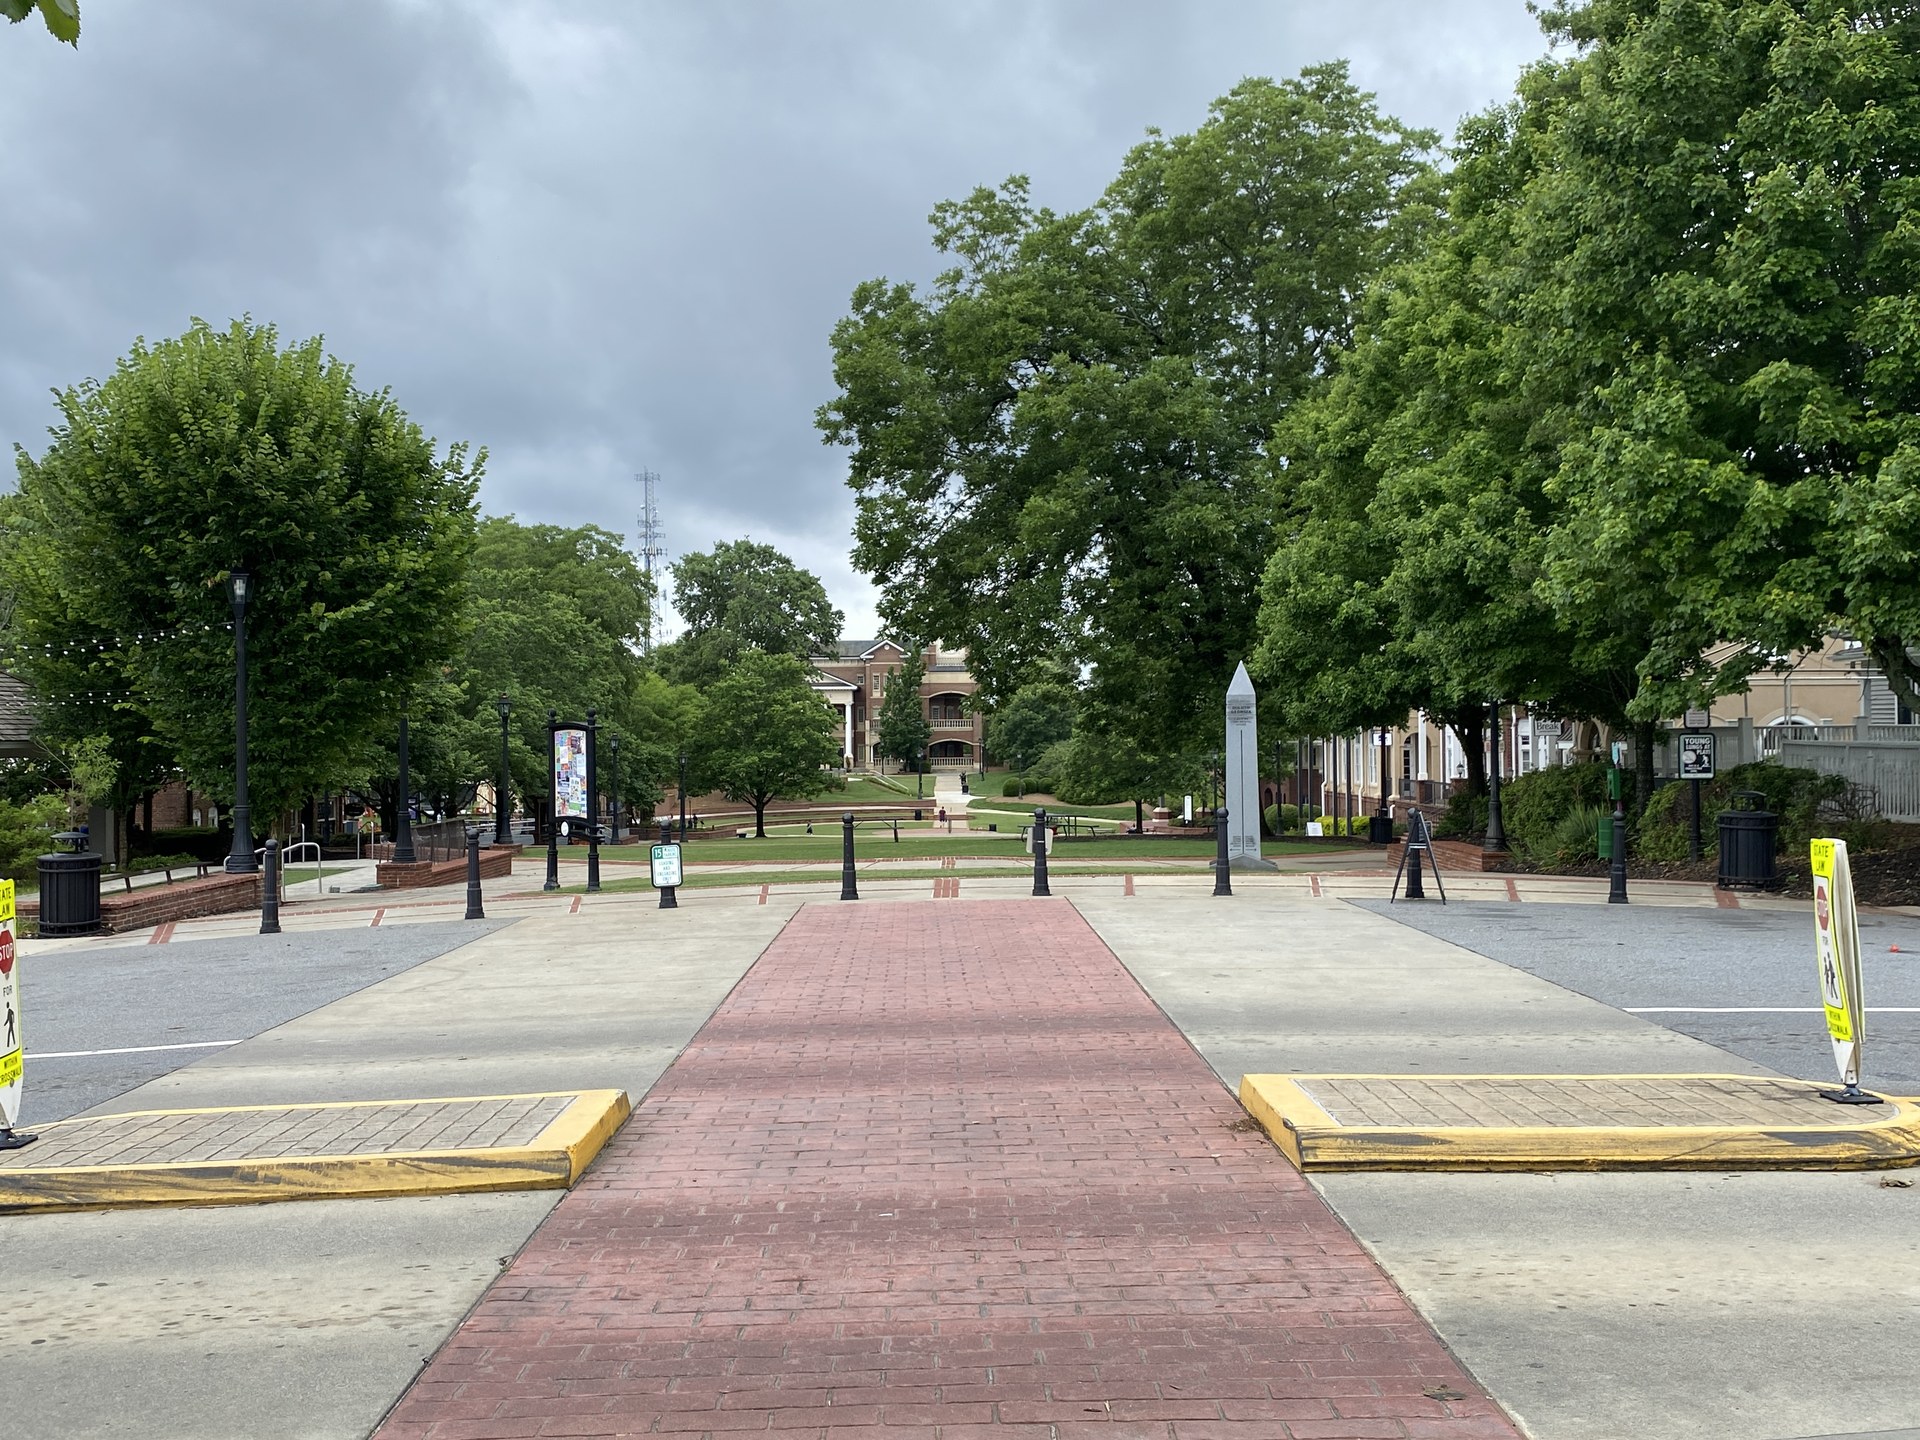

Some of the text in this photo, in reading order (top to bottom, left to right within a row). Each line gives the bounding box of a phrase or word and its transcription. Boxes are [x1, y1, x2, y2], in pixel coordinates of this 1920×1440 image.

[1537, 722, 1559, 730] Break
[654, 848, 662, 858] 15
[1814, 844, 1829, 858] STATE
[1816, 861, 1825, 872] LAW
[1817, 899, 1828, 918] STOP
[0, 942, 13, 960] STOP
[3, 984, 12, 996] FOR
